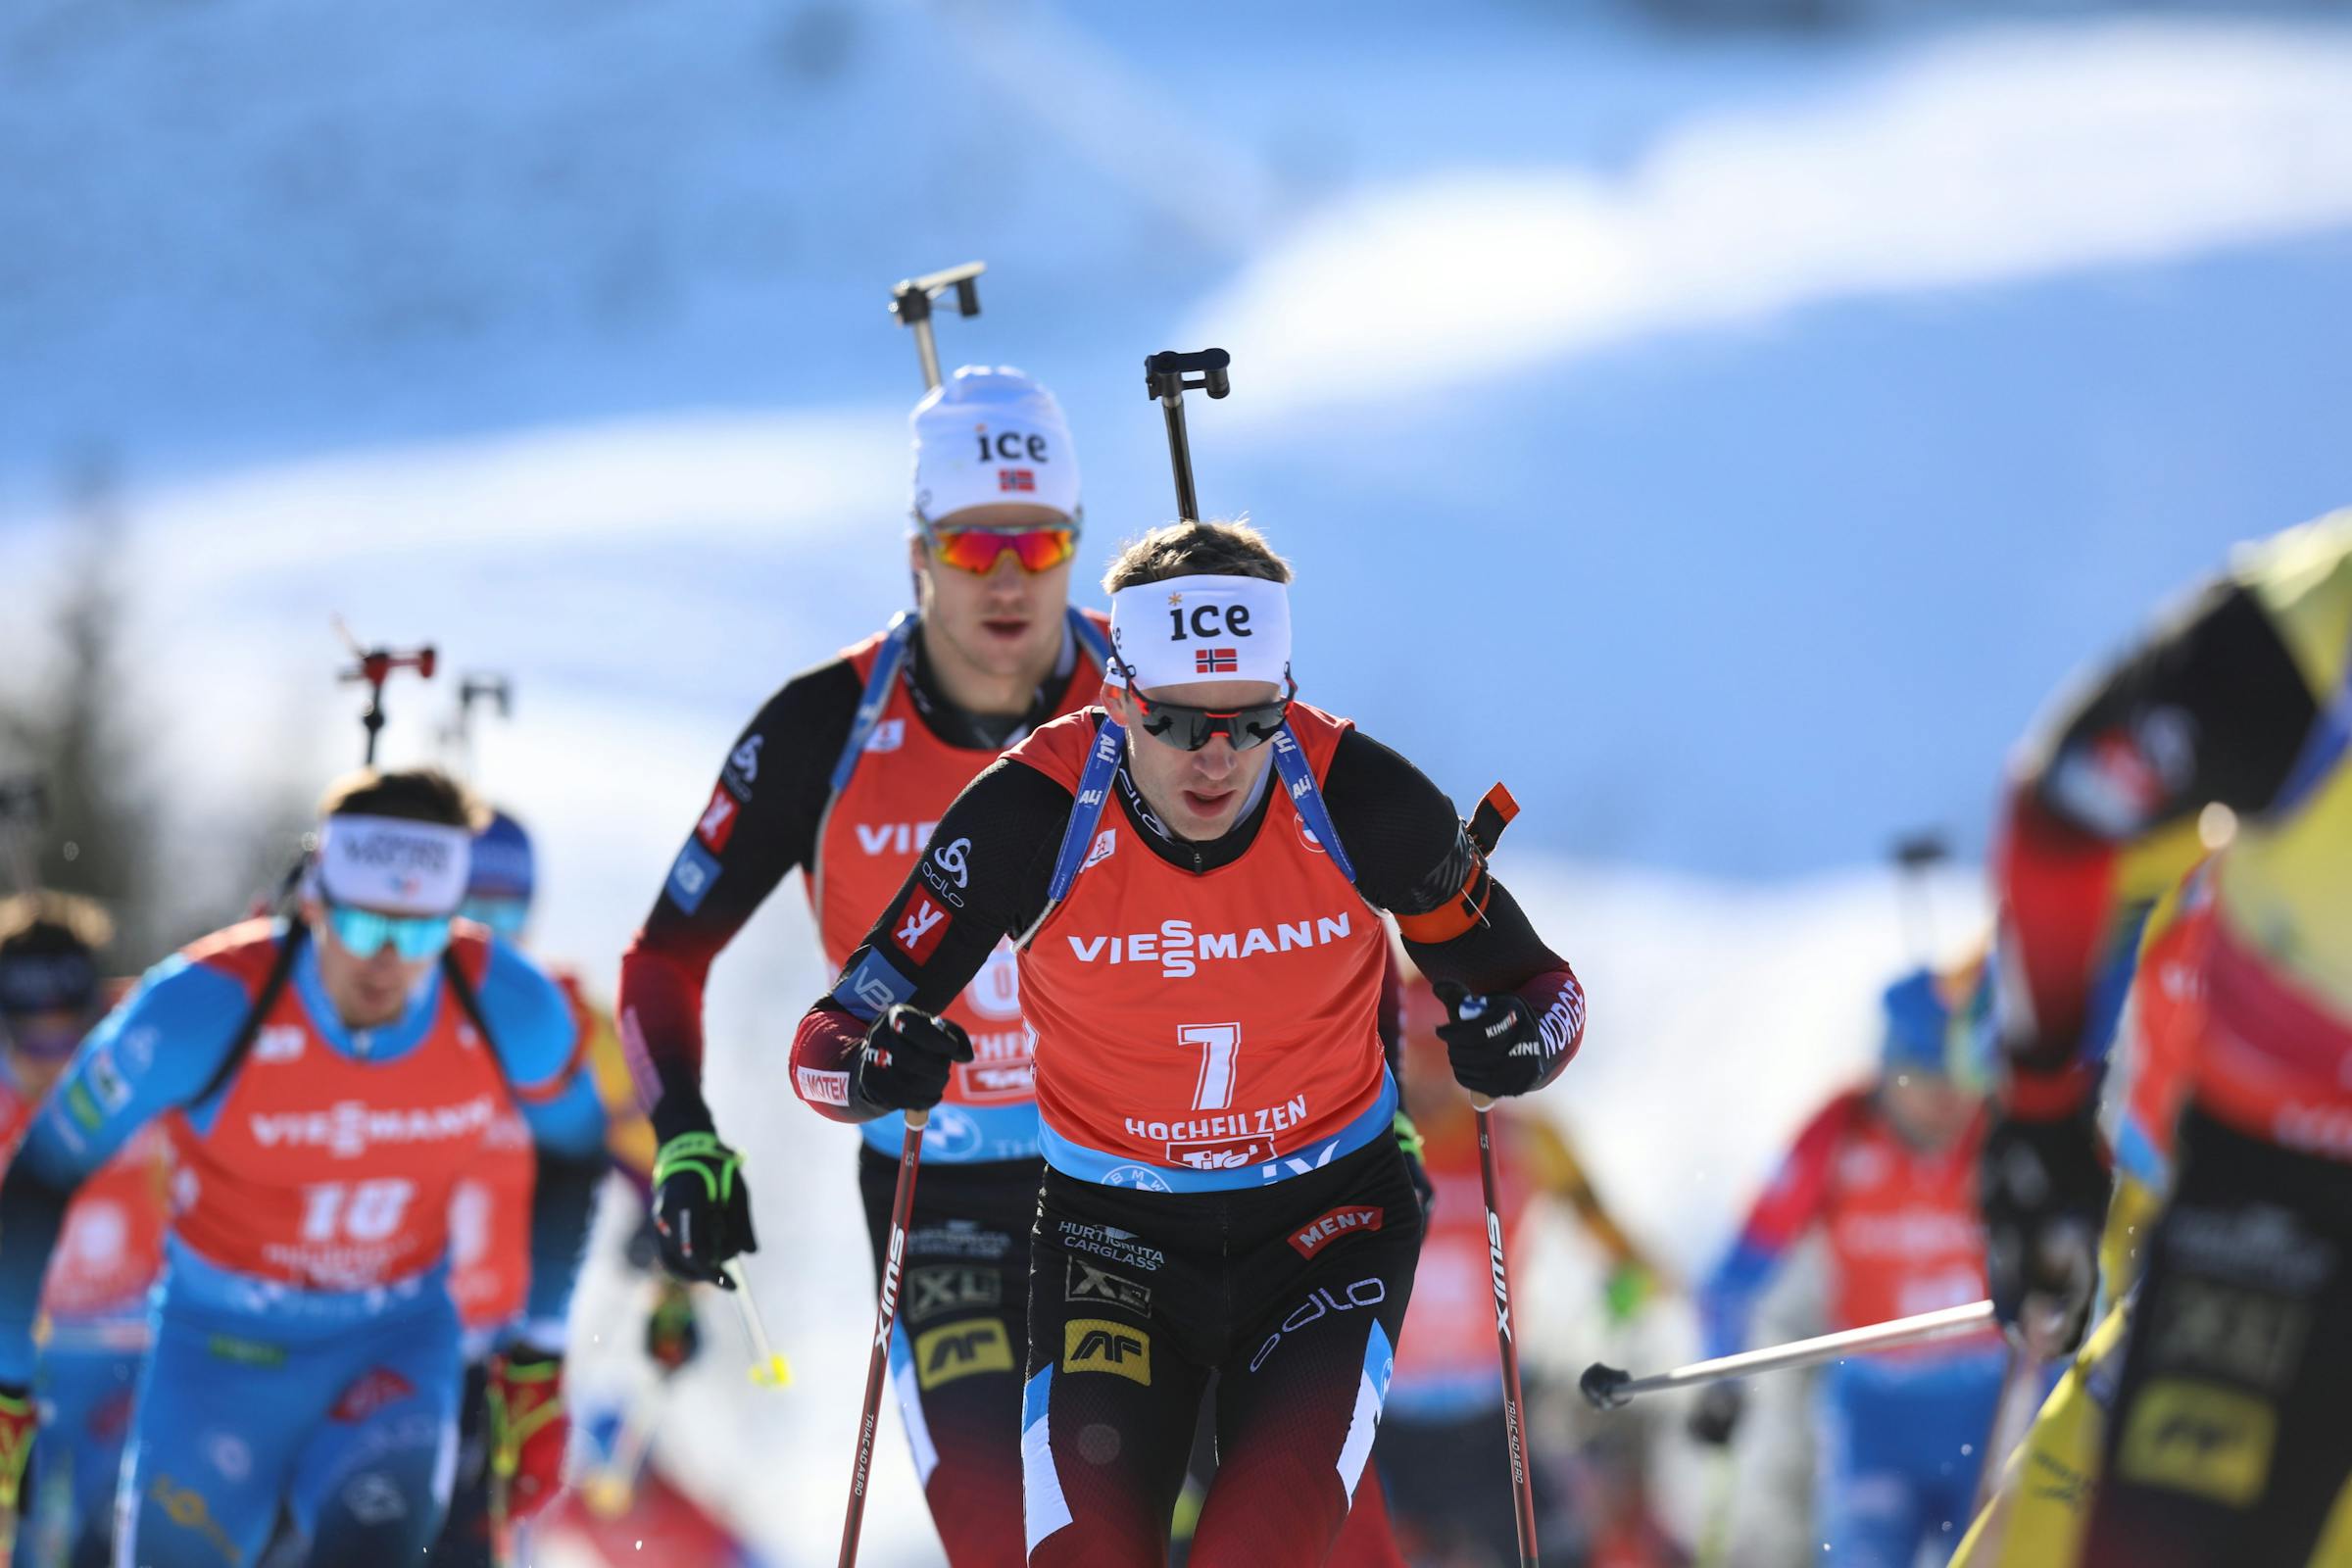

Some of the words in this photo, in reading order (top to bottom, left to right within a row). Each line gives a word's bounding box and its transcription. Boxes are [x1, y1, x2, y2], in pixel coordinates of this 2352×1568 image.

[974, 422, 1050, 464] ice
[1167, 592, 1252, 641] ice
[1067, 911, 1351, 978] VIESSMANN
[1177, 1021, 1242, 1111] 7
[1125, 1094, 1308, 1141] HOCHFILZEN
[1298, 1211, 1375, 1250] MENY
[1063, 1236, 1158, 1271] CARGLASS
[1485, 1205, 1512, 1345] SWIX
[874, 1220, 905, 1358] SWIX
[1070, 1330, 1142, 1363] AF
[861, 1412, 874, 1446] TRIAC
[1507, 1399, 1518, 1434] TRIAC
